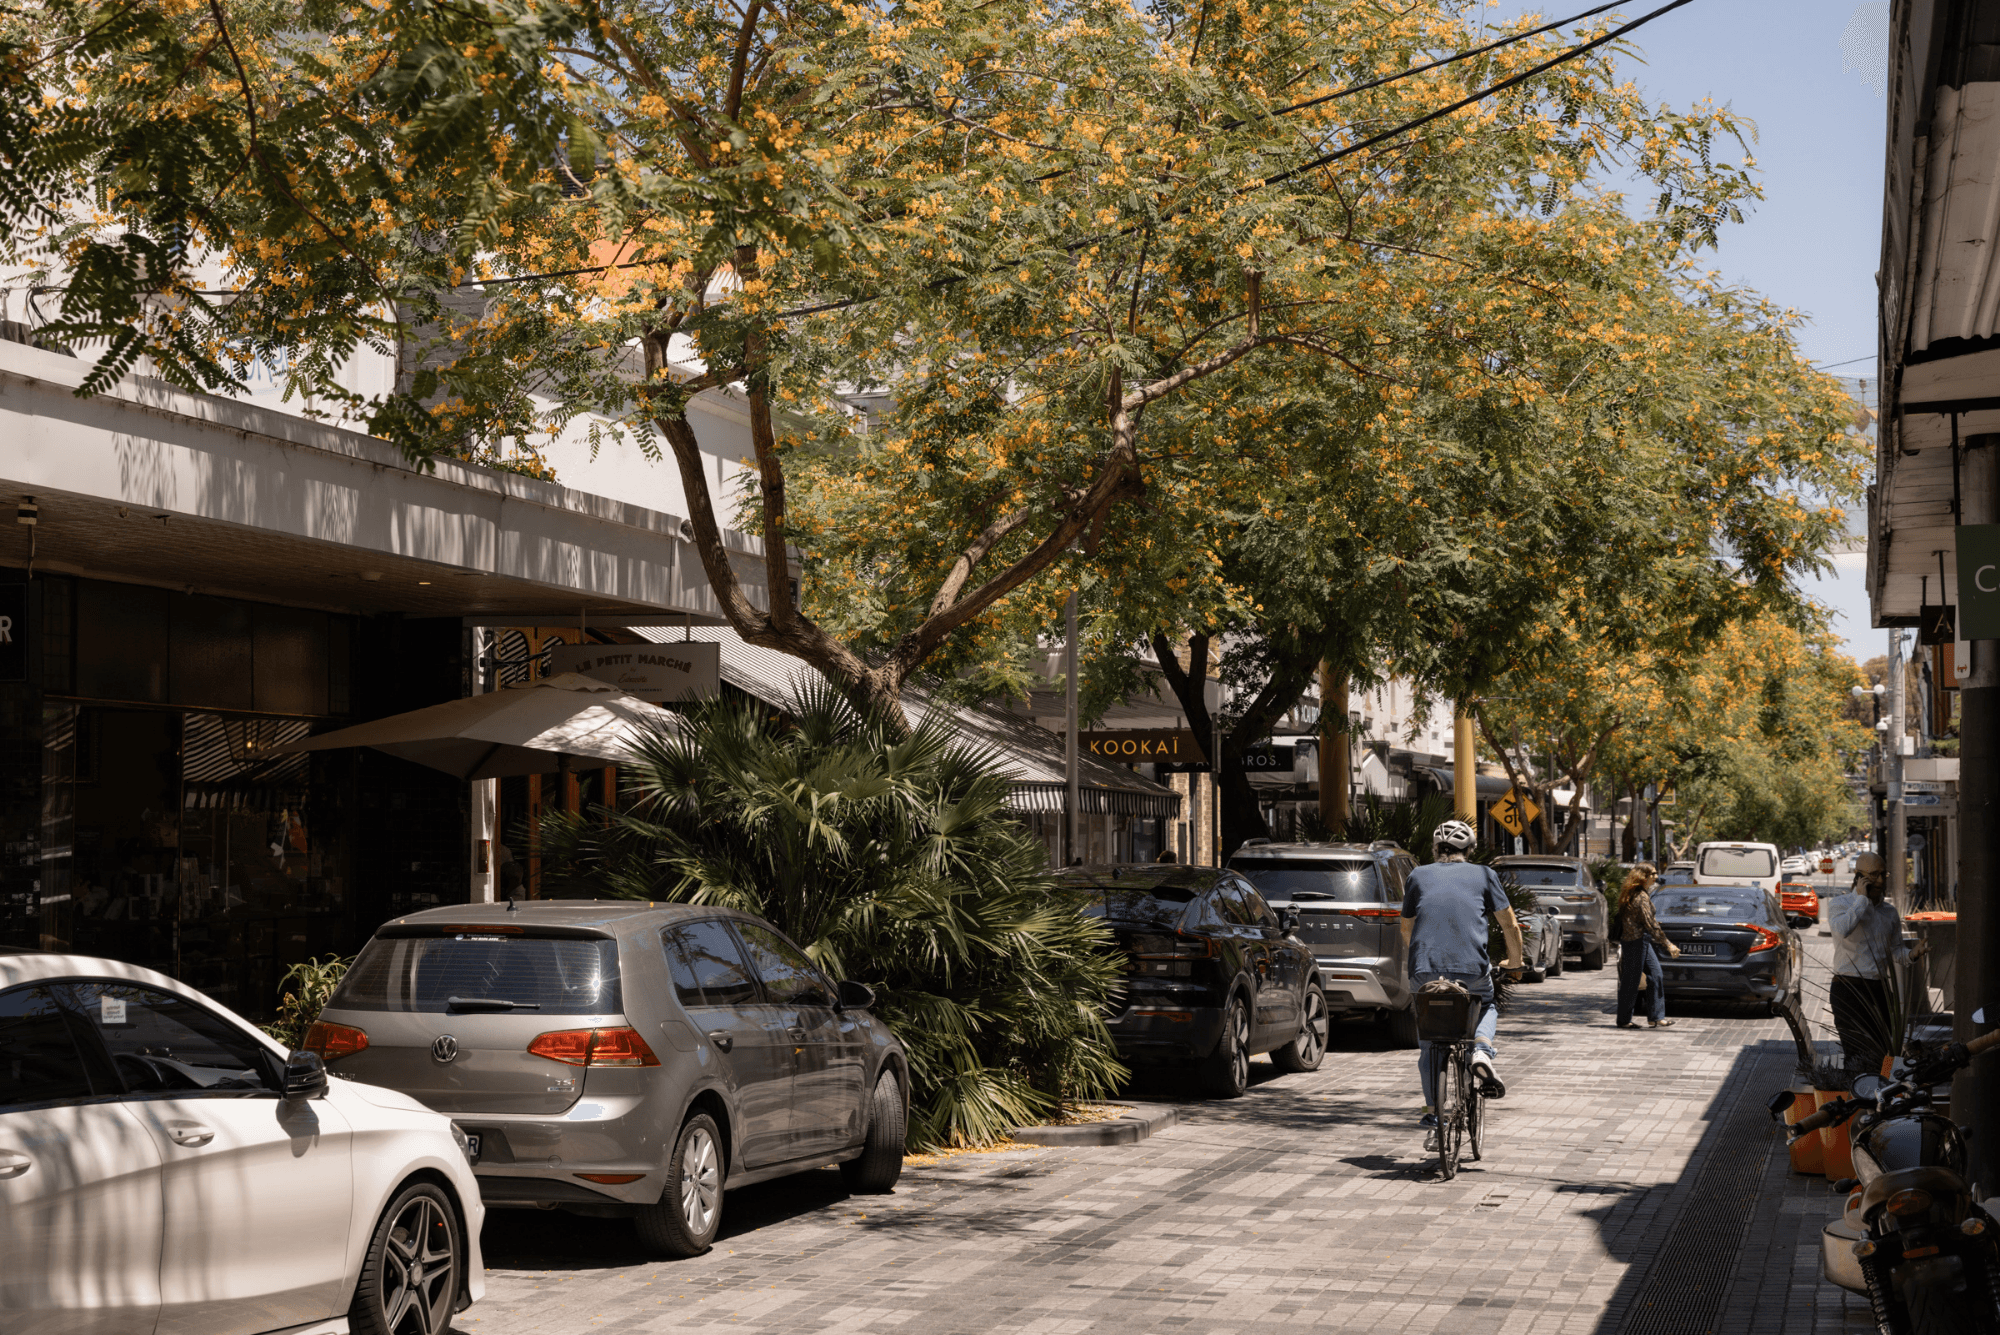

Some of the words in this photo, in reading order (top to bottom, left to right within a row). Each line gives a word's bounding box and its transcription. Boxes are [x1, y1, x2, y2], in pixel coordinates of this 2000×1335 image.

[1975, 565, 2000, 592] C
[576, 660, 592, 673] LE
[597, 654, 632, 667] PETIT
[638, 654, 692, 673] MARCHÉ
[1090, 737, 1178, 755] KOOKAÏ
